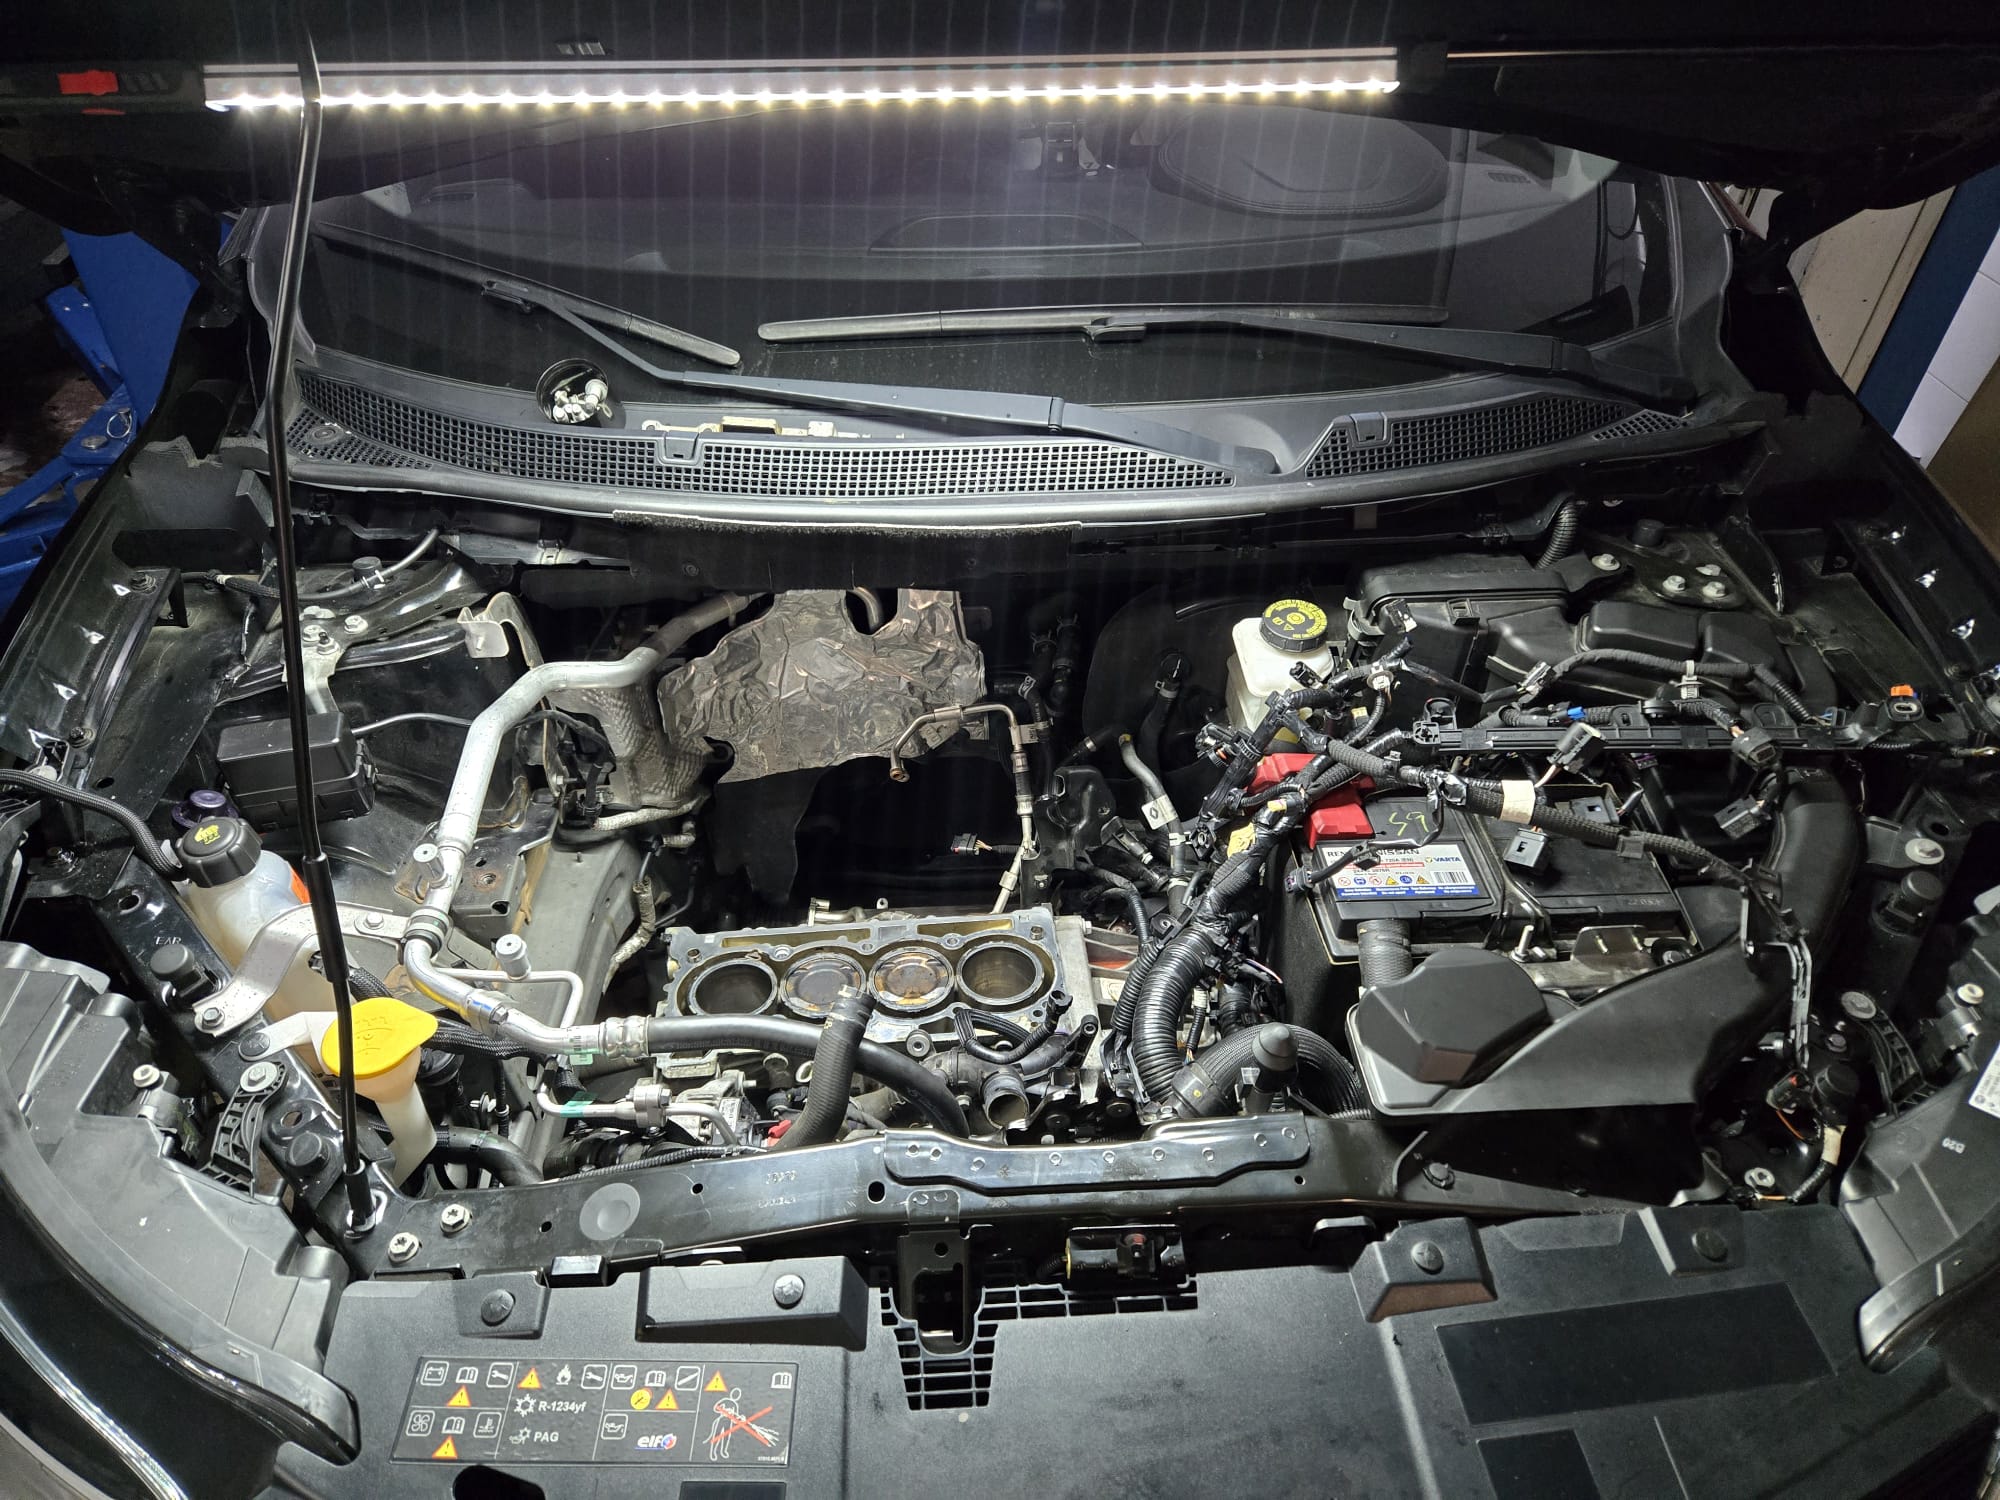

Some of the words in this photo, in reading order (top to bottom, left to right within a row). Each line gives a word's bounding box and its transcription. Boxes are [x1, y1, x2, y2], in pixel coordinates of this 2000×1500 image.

[538, 1401, 587, 1414] R-1234yf
[533, 1431, 559, 1442] PAG
[637, 1434, 664, 1448] elf
